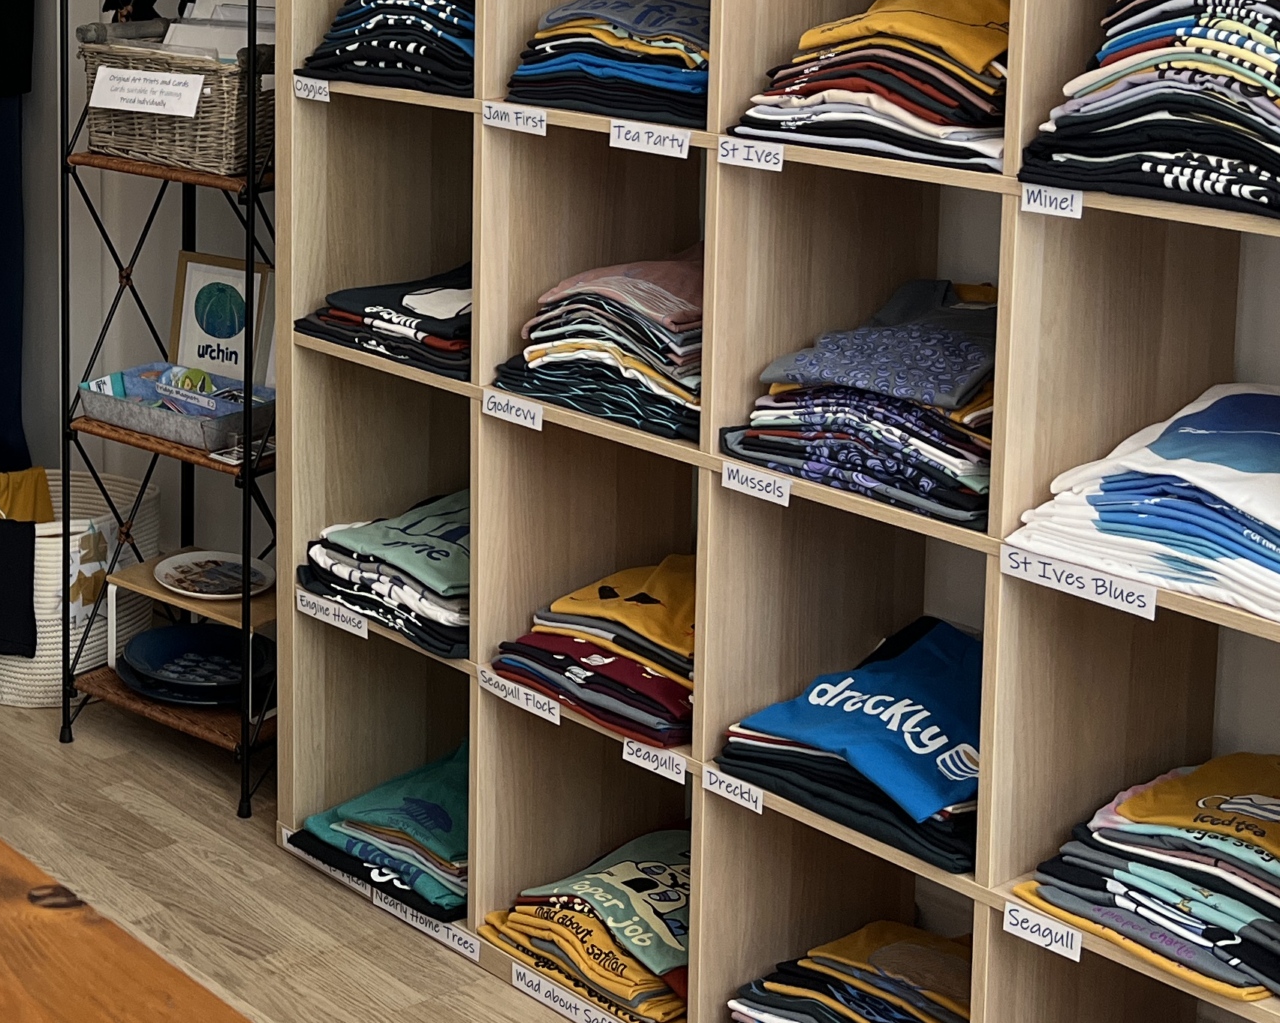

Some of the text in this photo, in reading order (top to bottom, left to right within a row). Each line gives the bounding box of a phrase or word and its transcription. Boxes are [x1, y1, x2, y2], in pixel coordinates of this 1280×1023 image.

[109, 74, 131, 85] Original
[143, 77, 159, 86] Prints
[172, 79, 189, 88] Cards
[110, 85, 125, 93] Cards
[149, 88, 158, 96] for
[159, 89, 182, 100] framing
[295, 79, 329, 98] Oggies
[120, 96, 136, 104] Priced
[483, 105, 545, 129] Jam First
[613, 124, 685, 154] Tea Party
[720, 141, 781, 165] St Ives
[1026, 188, 1074, 213] Mine!
[198, 343, 238, 365] urchin
[486, 395, 536, 426] Godrevy
[727, 467, 784, 498] Mussels
[1007, 552, 1148, 609] St Ives Blues
[299, 594, 363, 630] Engine House
[480, 670, 556, 717] Seagull Flock
[626, 740, 683, 775] Seagulls
[706, 769, 759, 810] Dreckly
[375, 890, 475, 954] Nearly Home Trees
[607, 915, 654, 946] job
[1008, 908, 1075, 951] Seagull
[534, 905, 628, 976] mad about saffron
[515, 968, 541, 995] Mad
[544, 988, 580, 1016] about
